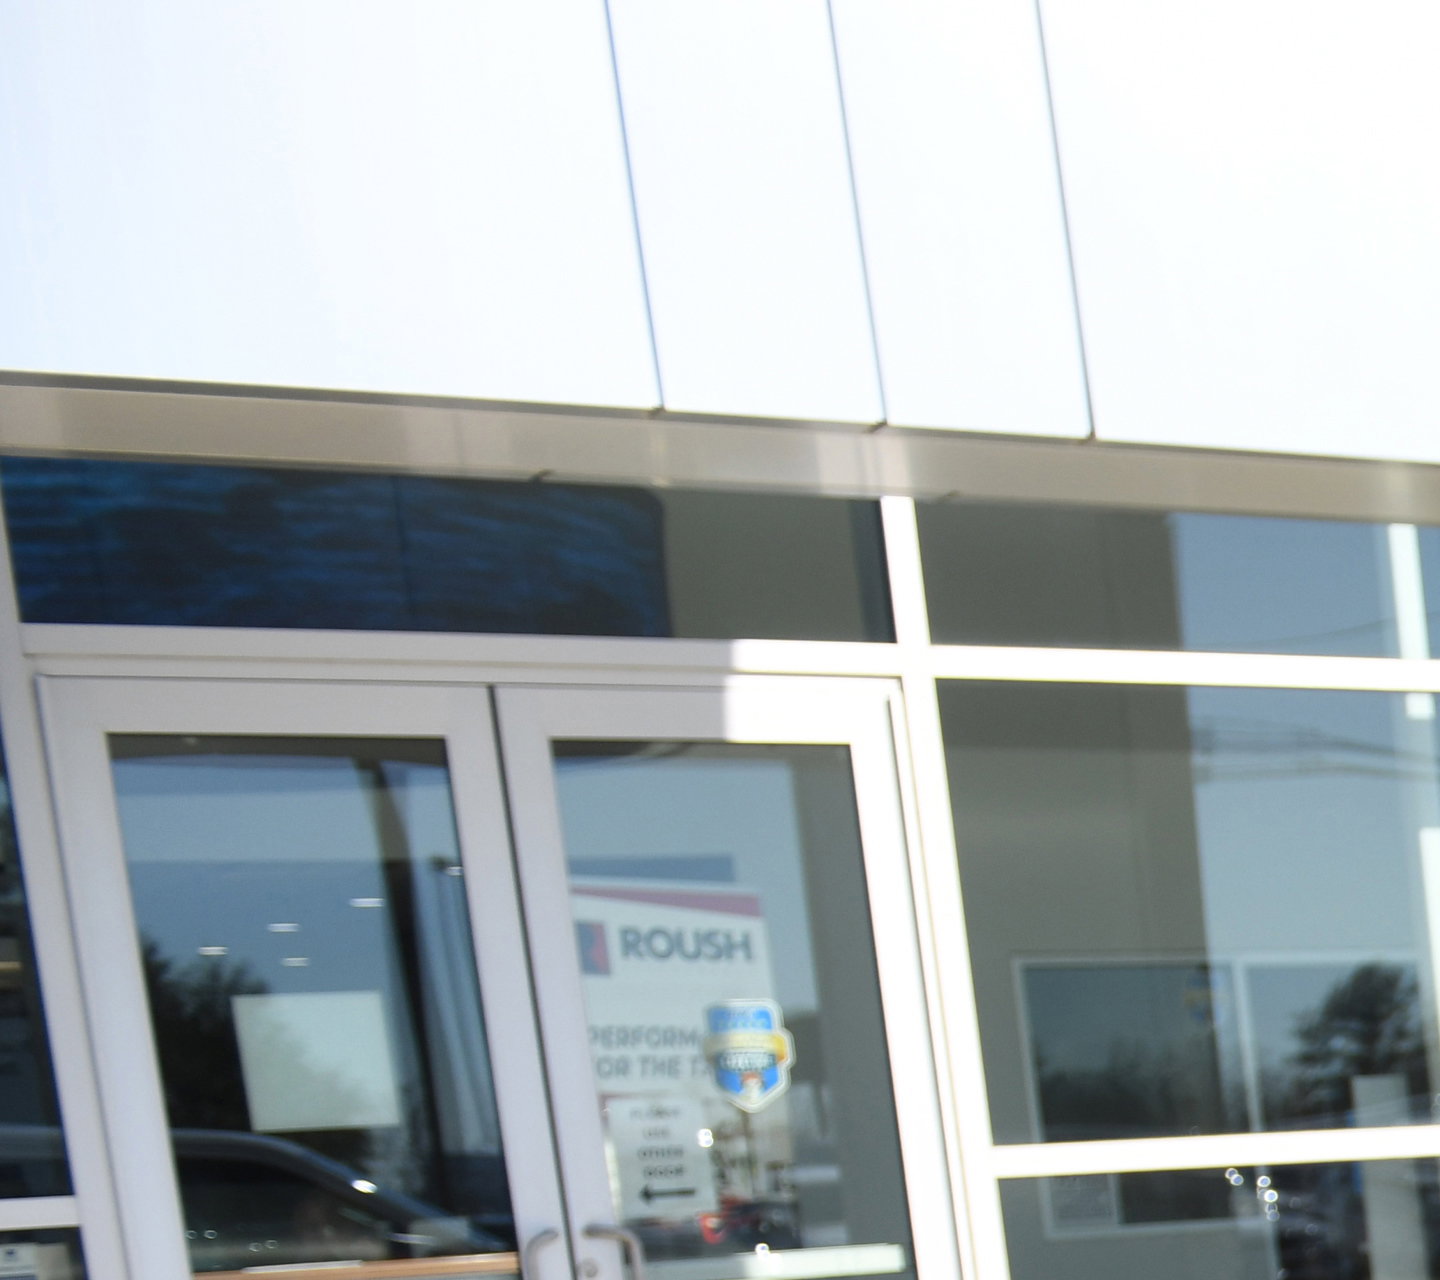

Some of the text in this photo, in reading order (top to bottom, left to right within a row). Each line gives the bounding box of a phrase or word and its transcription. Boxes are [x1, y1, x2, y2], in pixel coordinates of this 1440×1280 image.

[619, 926, 753, 961] ROUSH
[588, 1025, 704, 1049] PERFORM
[595, 1054, 631, 1079] OR
[637, 1055, 681, 1078] THE
